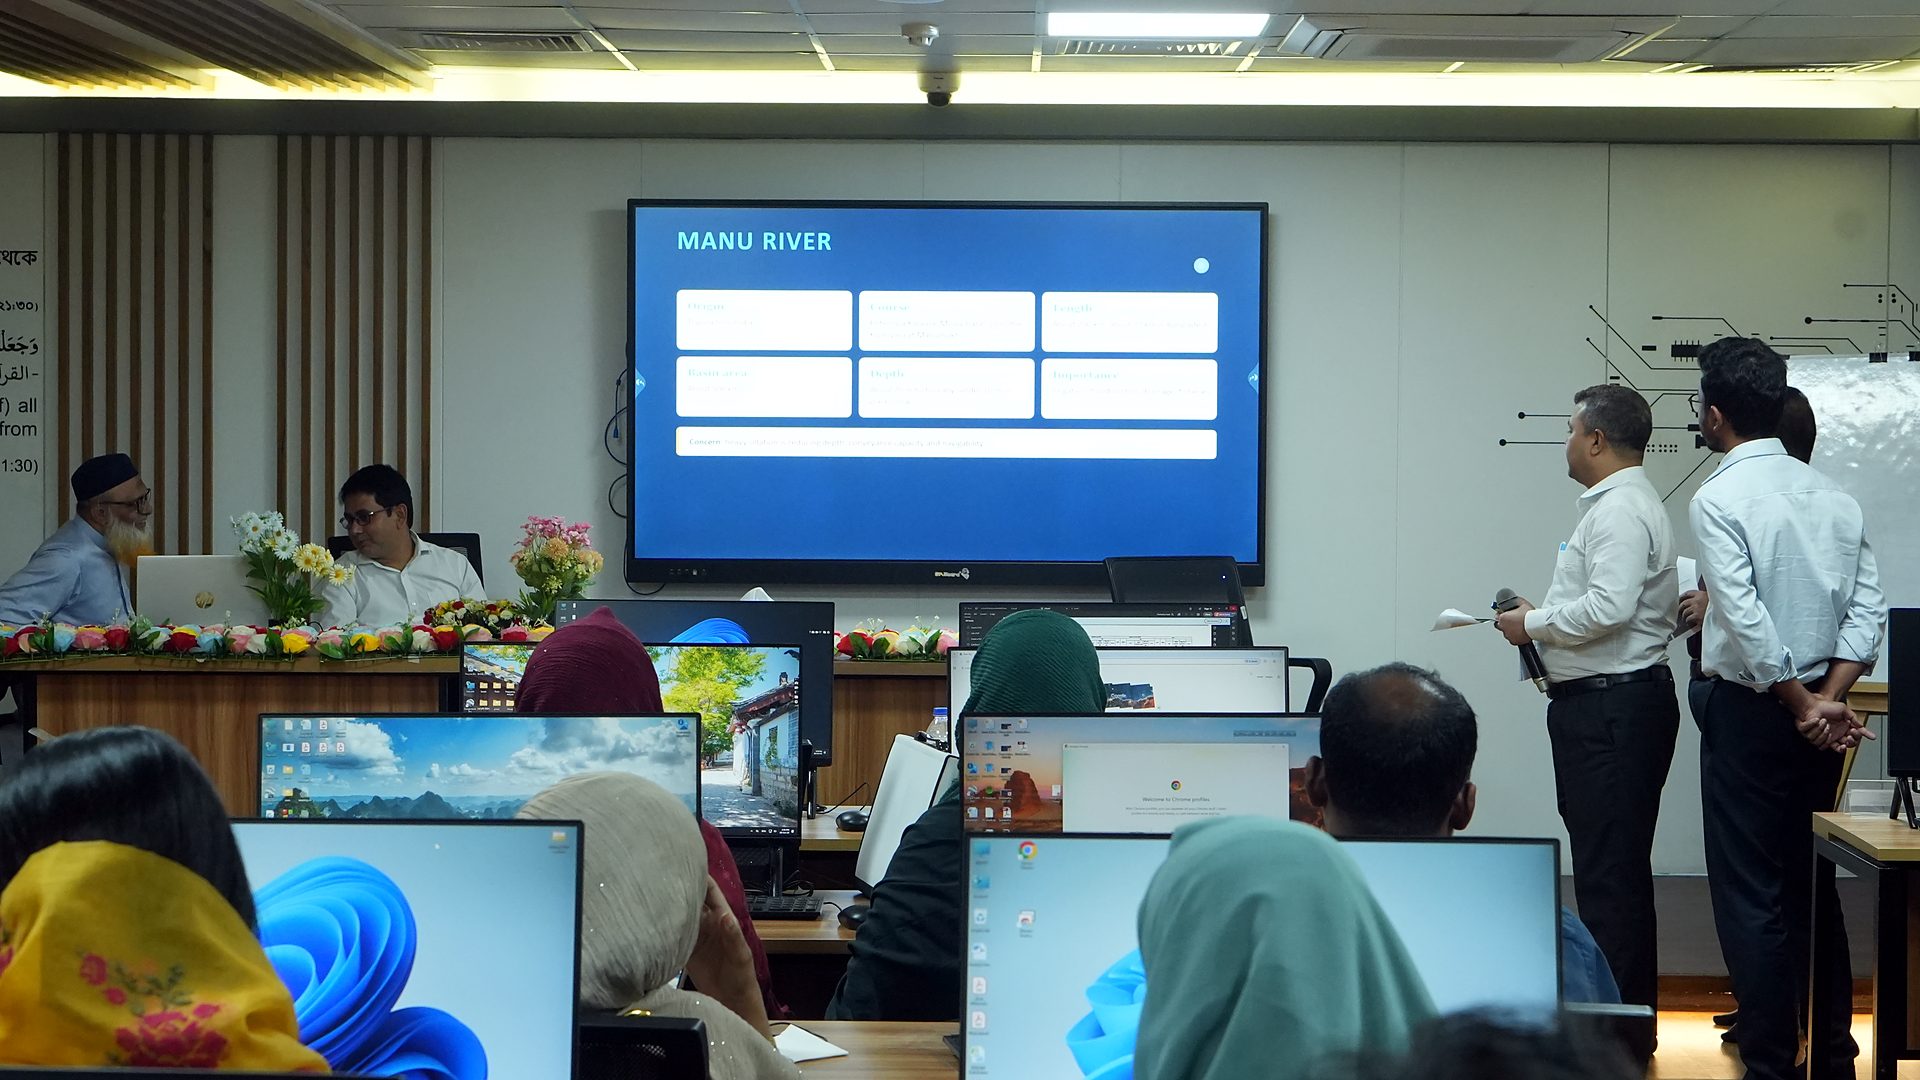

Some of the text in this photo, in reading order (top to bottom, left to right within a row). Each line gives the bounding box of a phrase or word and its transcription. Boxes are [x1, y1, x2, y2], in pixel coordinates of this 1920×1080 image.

[677, 231, 832, 251] MANU RIVER
[0, 250, 38, 266] থকে
[18, 397, 37, 413] all
[0, 421, 37, 437] from
